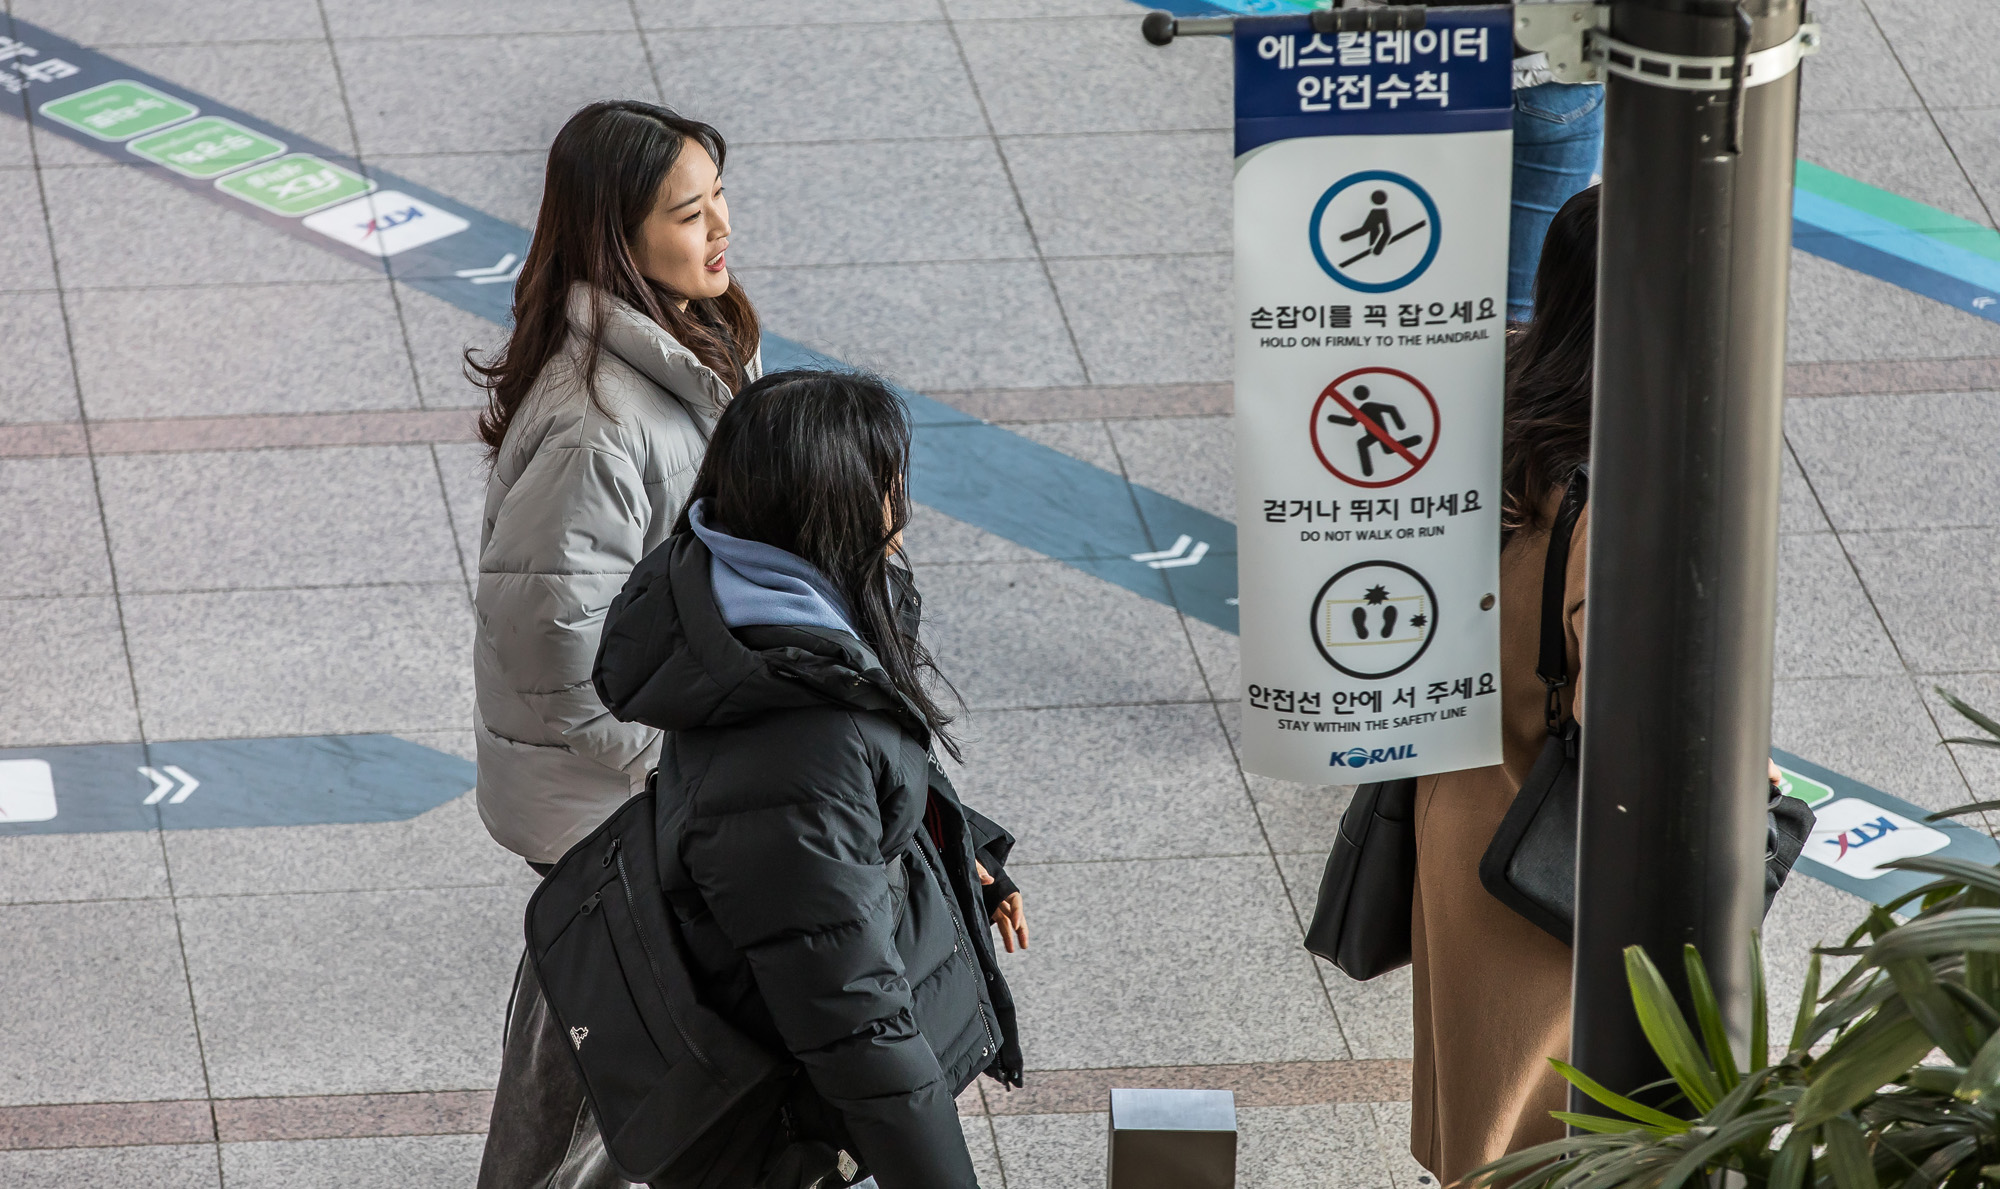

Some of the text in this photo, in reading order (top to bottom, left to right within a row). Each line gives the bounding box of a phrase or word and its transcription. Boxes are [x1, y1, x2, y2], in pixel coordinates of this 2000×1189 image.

[1257, 27, 1488, 69] 에스컬레이터
[1297, 70, 1449, 112] 안전수칙
[354, 206, 425, 241] KTX
[1249, 296, 1497, 330] 손잡이를 꼭 잡으세요
[1260, 329, 1490, 348] HOLD ON FIRMLY TO THE HANDRAIL
[1263, 489, 1483, 524] 걷거나 뛰지 마세요
[1300, 525, 1445, 542] DO NOT WALK OR RUN
[1247, 672, 1497, 716] 안전선 안에 서 주세요
[1277, 705, 1468, 733] STAY WITHIN THE SAFETY LINE
[1328, 743, 1418, 769] KORAIL
[1823, 815, 1899, 863] KTX
